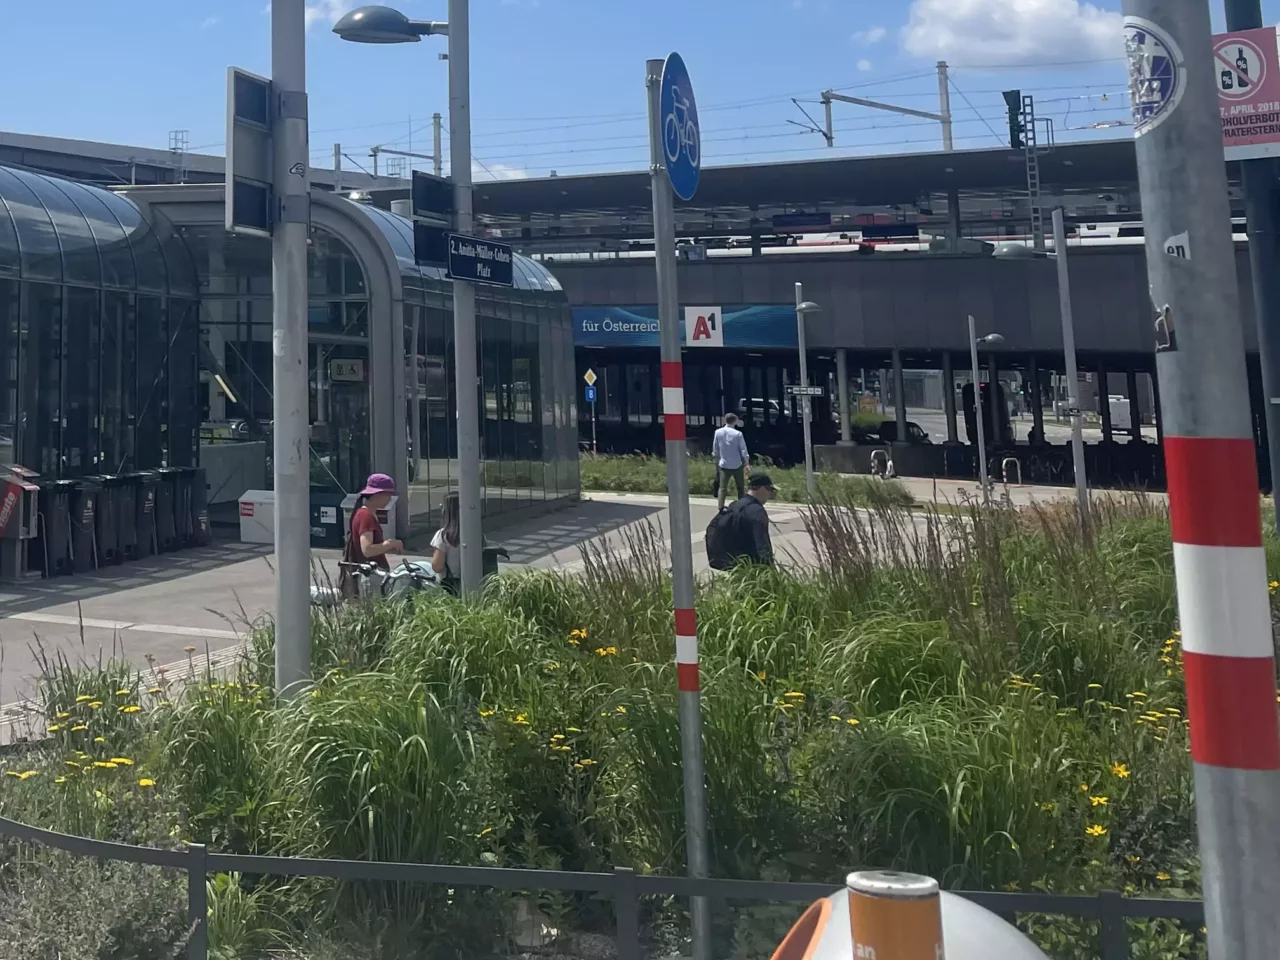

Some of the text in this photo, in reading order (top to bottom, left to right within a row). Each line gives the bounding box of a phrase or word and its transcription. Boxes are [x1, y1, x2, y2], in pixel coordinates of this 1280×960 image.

[1230, 104, 1256, 115] APRIL
[1257, 101, 1280, 112] 2018
[1221, 124, 1280, 138] RATERSTERN
[476, 263, 491, 278] Platz
[582, 319, 599, 332] für
[692, 312, 717, 341] A1
